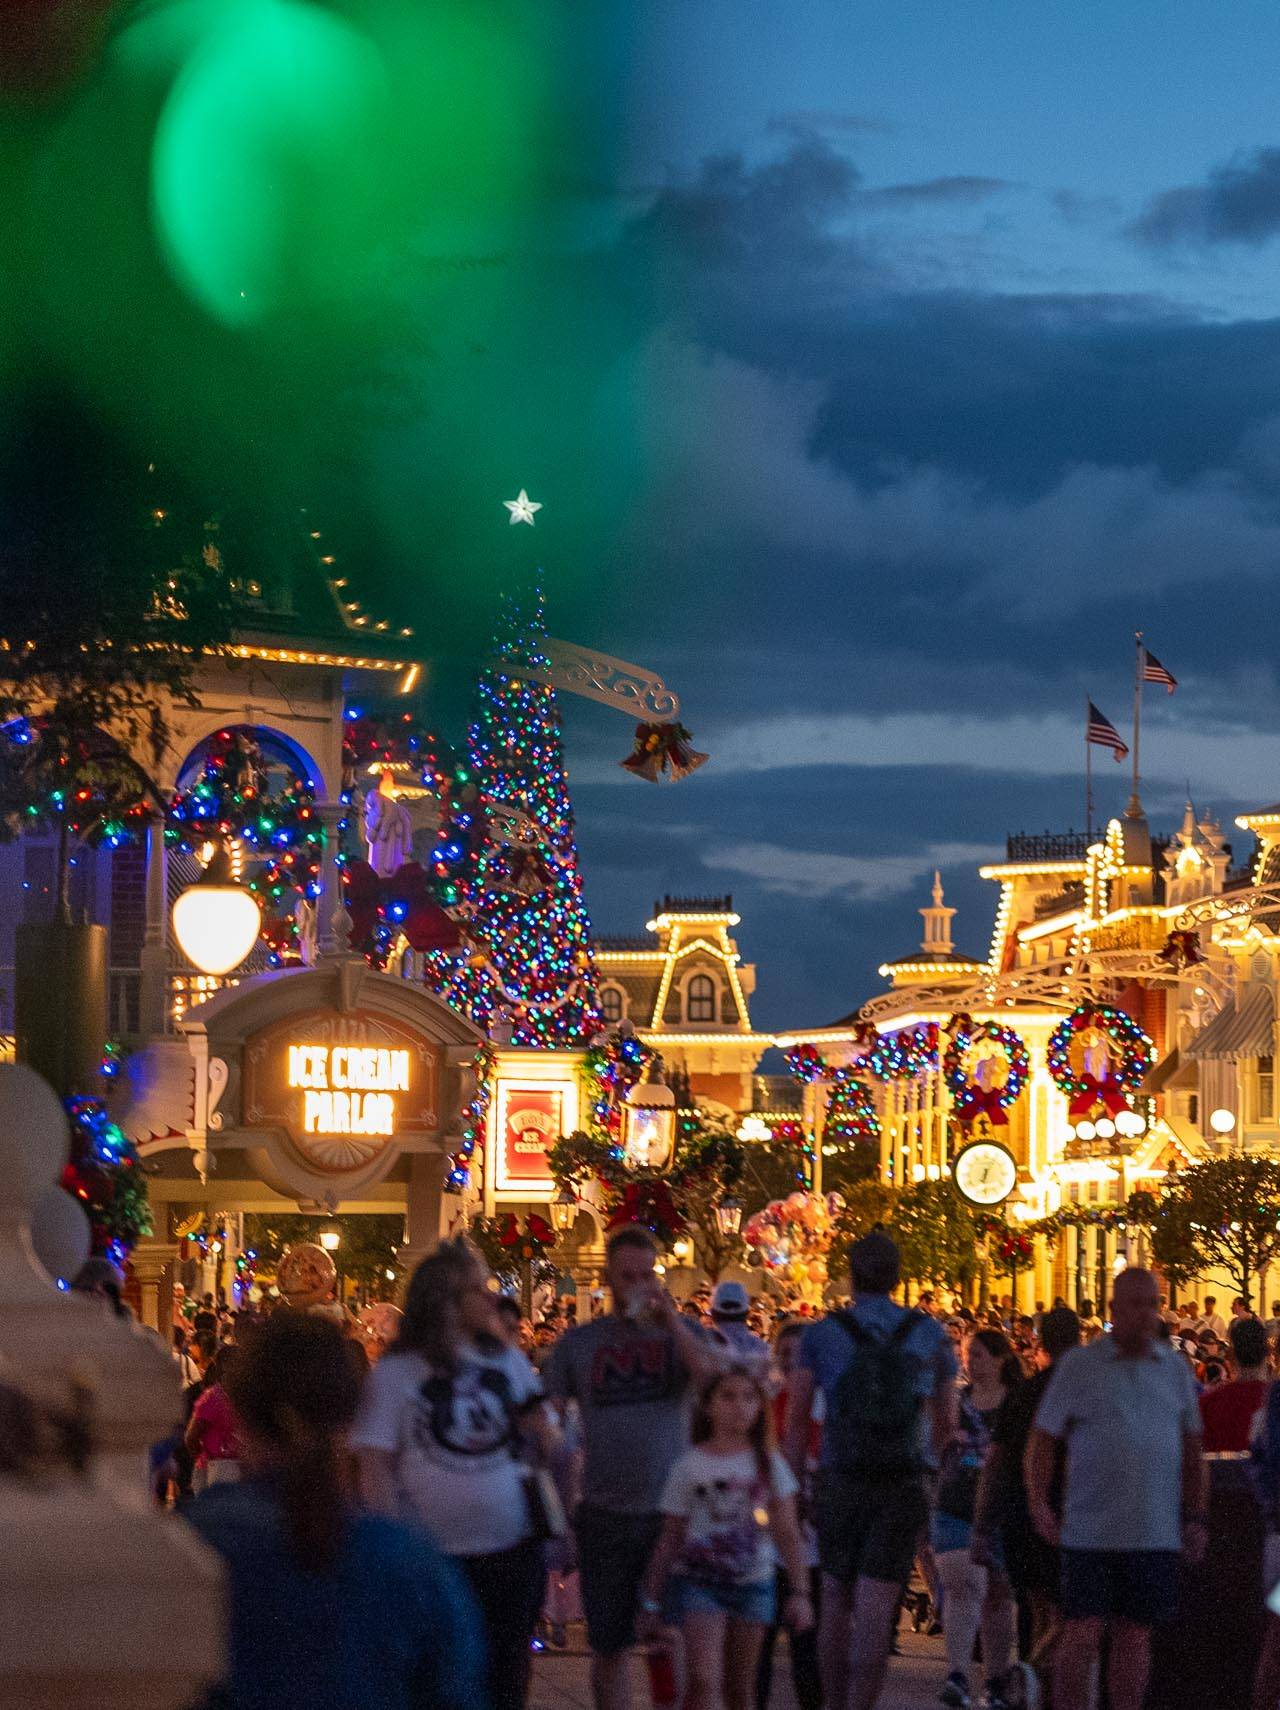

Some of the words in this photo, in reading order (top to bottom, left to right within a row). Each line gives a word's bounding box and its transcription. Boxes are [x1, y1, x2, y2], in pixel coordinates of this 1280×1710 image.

[288, 1045, 329, 1089] ICE
[331, 1046, 410, 1092] CREAM
[304, 1090, 395, 1136] PARLOR
